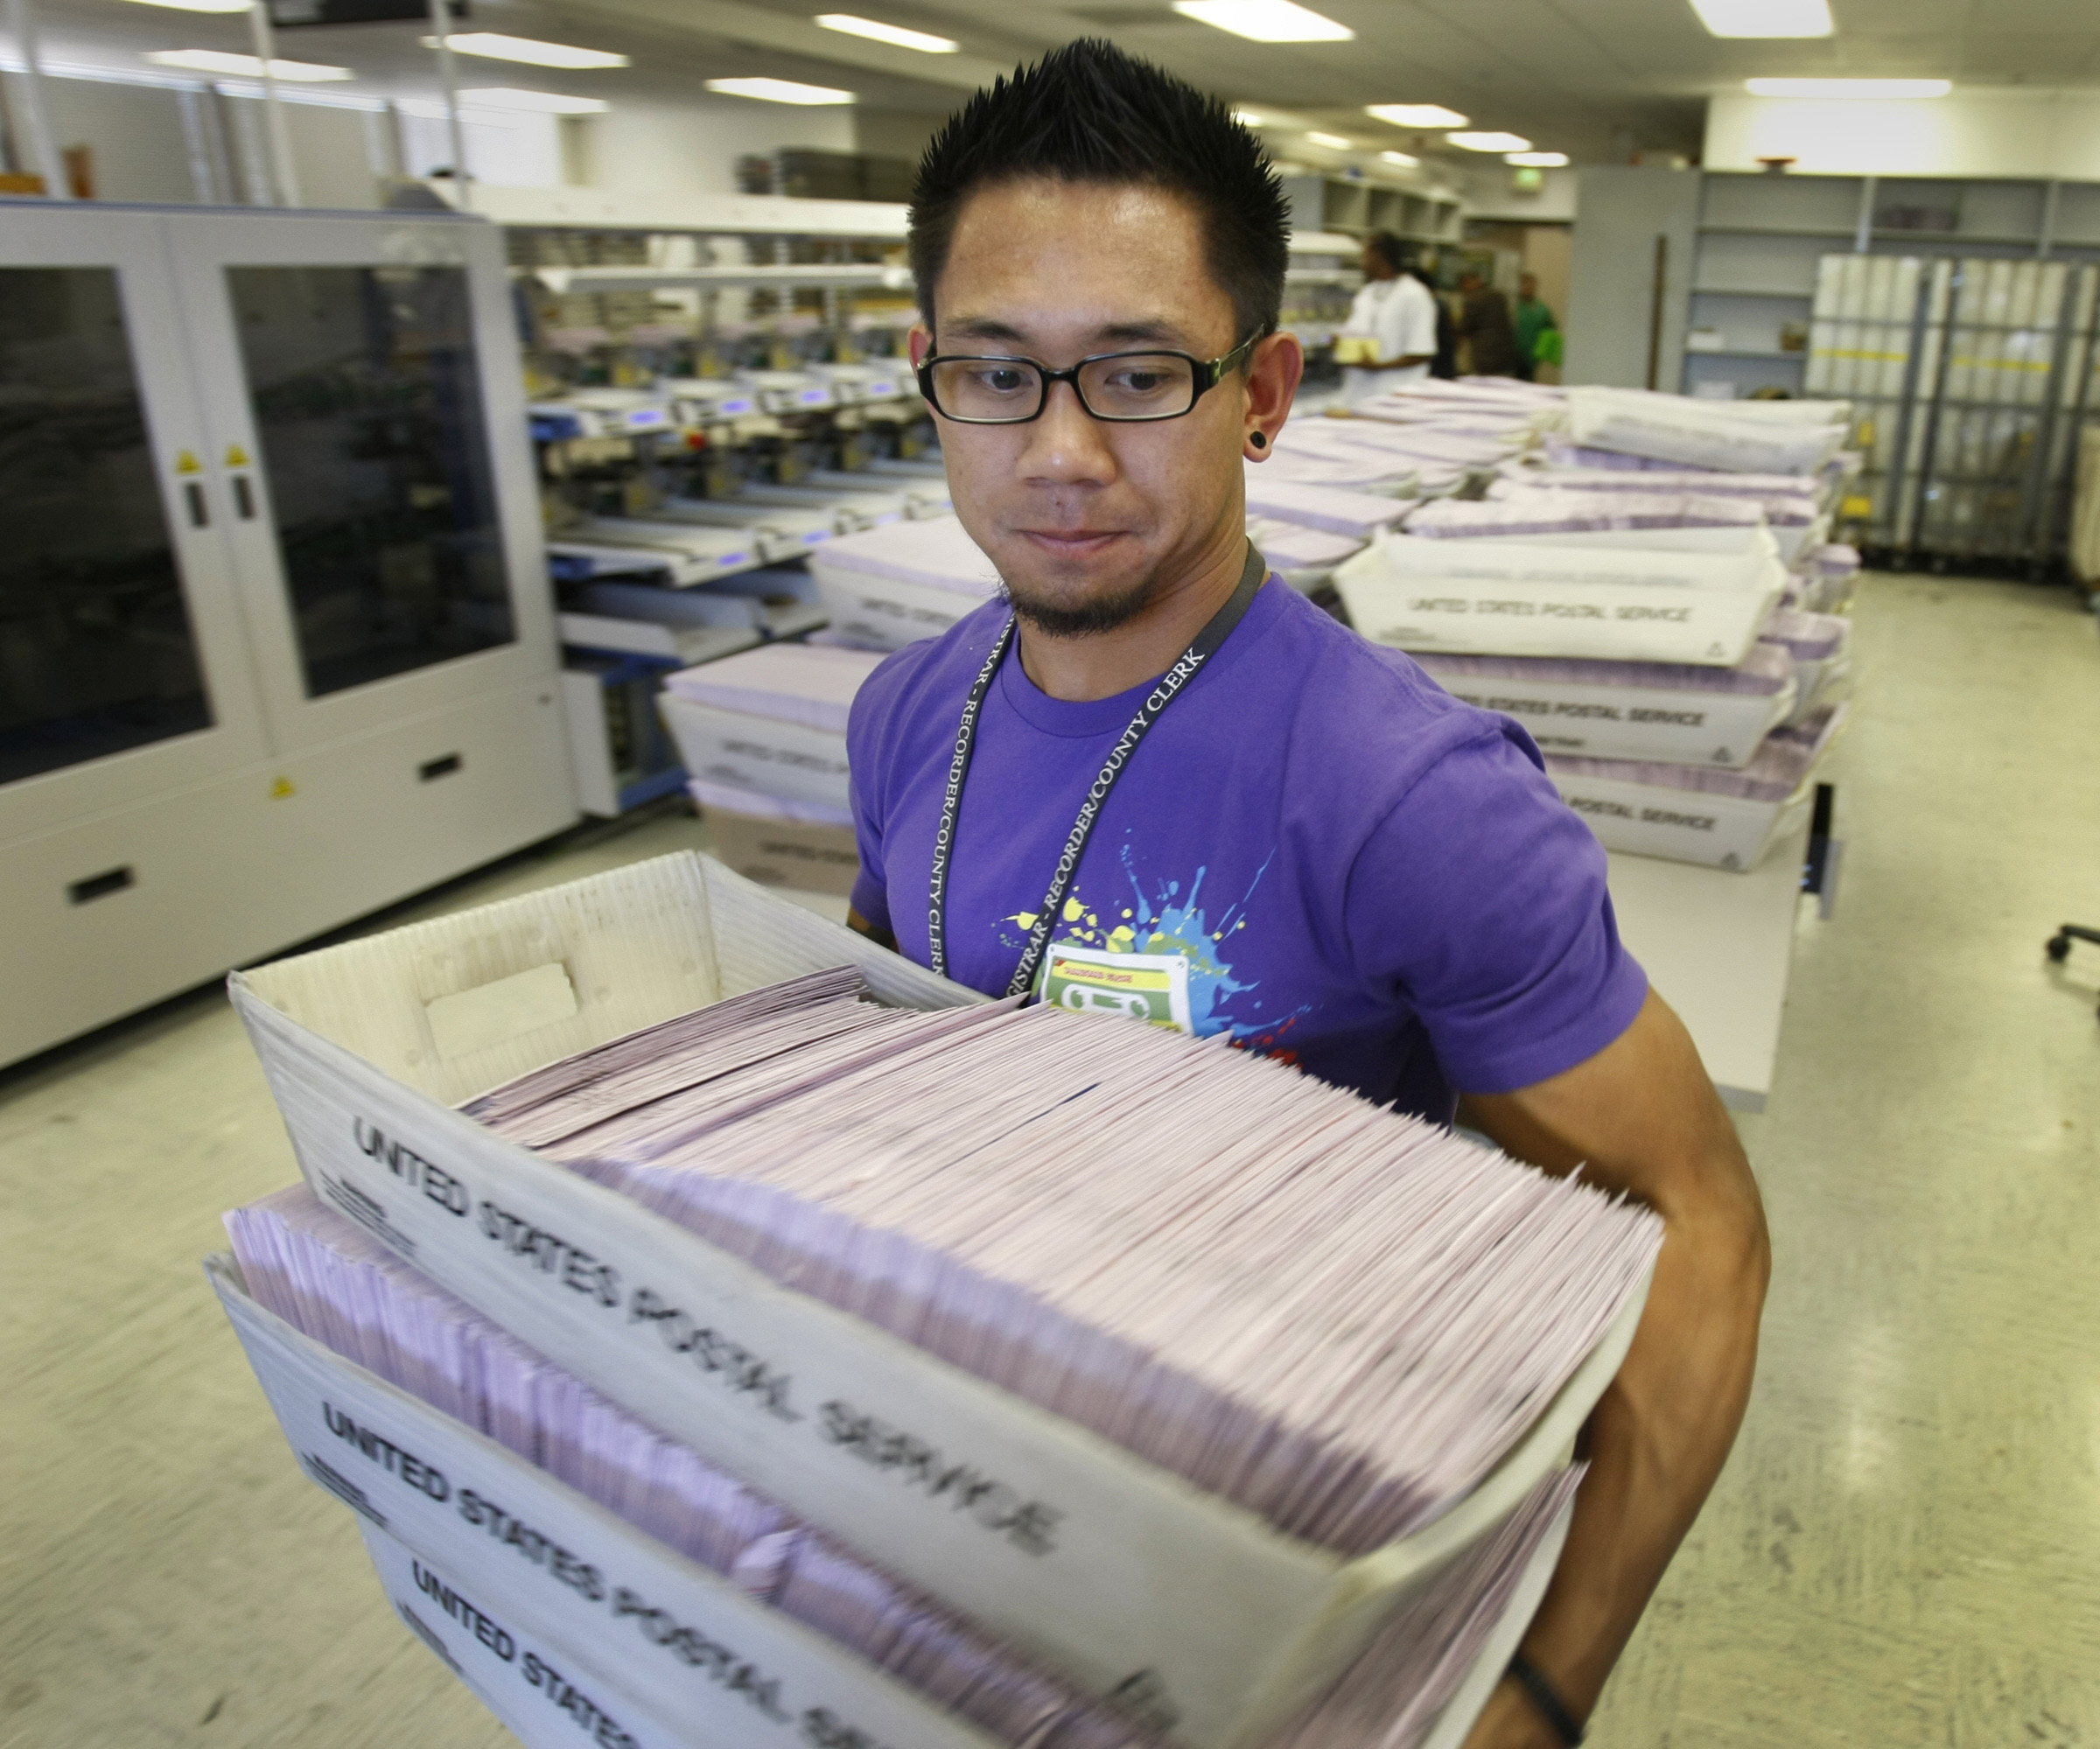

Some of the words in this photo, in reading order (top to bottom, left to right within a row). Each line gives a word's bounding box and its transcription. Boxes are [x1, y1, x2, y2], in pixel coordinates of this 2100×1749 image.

[1540, 602, 1605, 619] POSTAL
[1615, 605, 1691, 622] SERVICE
[1554, 703, 1620, 721] POSTAL
[1628, 708, 1705, 727] SERVICE
[929, 700, 977, 906] RECORDER/COUNTY
[1044, 710, 1149, 912] RECORDER/COUNTY
[1146, 647, 1206, 713] CLERK
[1641, 808, 1717, 831] SERVICE
[928, 909, 945, 978] CLERK
[353, 1115, 470, 1217] UNITED
[479, 1200, 621, 1308] STATES
[627, 1288, 806, 1424] POSTAL
[817, 1400, 1067, 1557] SERVICE
[323, 1401, 451, 1503] UNITED
[458, 1488, 605, 1602] STATES
[612, 1586, 792, 1724] POSTAL
[412, 1559, 515, 1662] UNITED
